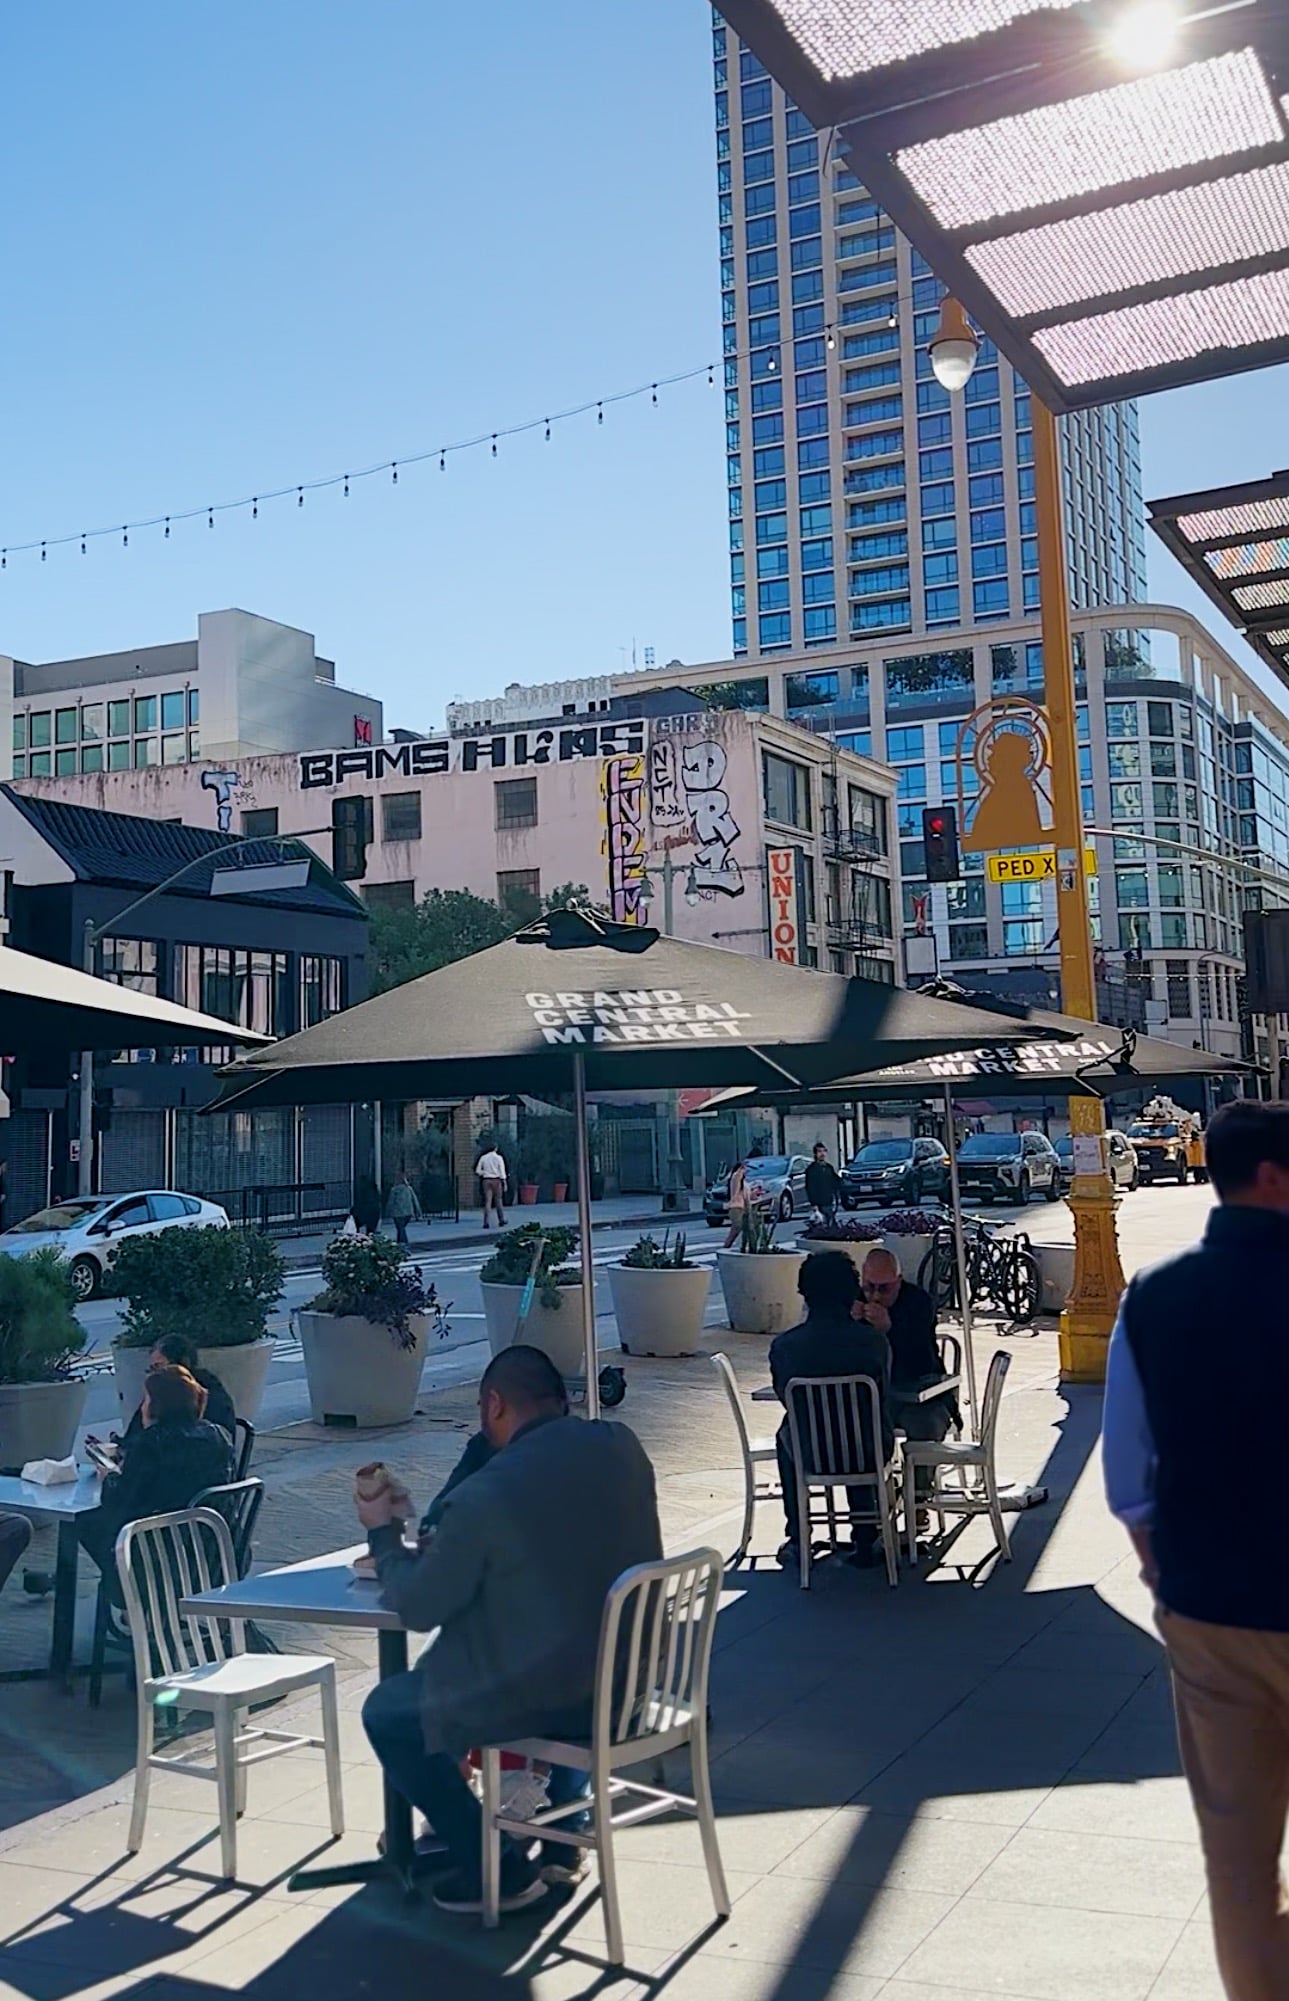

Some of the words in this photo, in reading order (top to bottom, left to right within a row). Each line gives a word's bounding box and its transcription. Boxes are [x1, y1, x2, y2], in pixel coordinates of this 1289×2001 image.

[300, 740, 449, 790] BAMS
[608, 757, 648, 927] ENDEM
[997, 859, 1034, 877] PED
[770, 852, 797, 965] UNION
[525, 988, 683, 1009] GRAND
[533, 1001, 753, 1027] CENTRAL
[541, 1020, 742, 1045] MARKET
[974, 1040, 1115, 1061] CENTRAL
[928, 1057, 1062, 1076] MARKET
